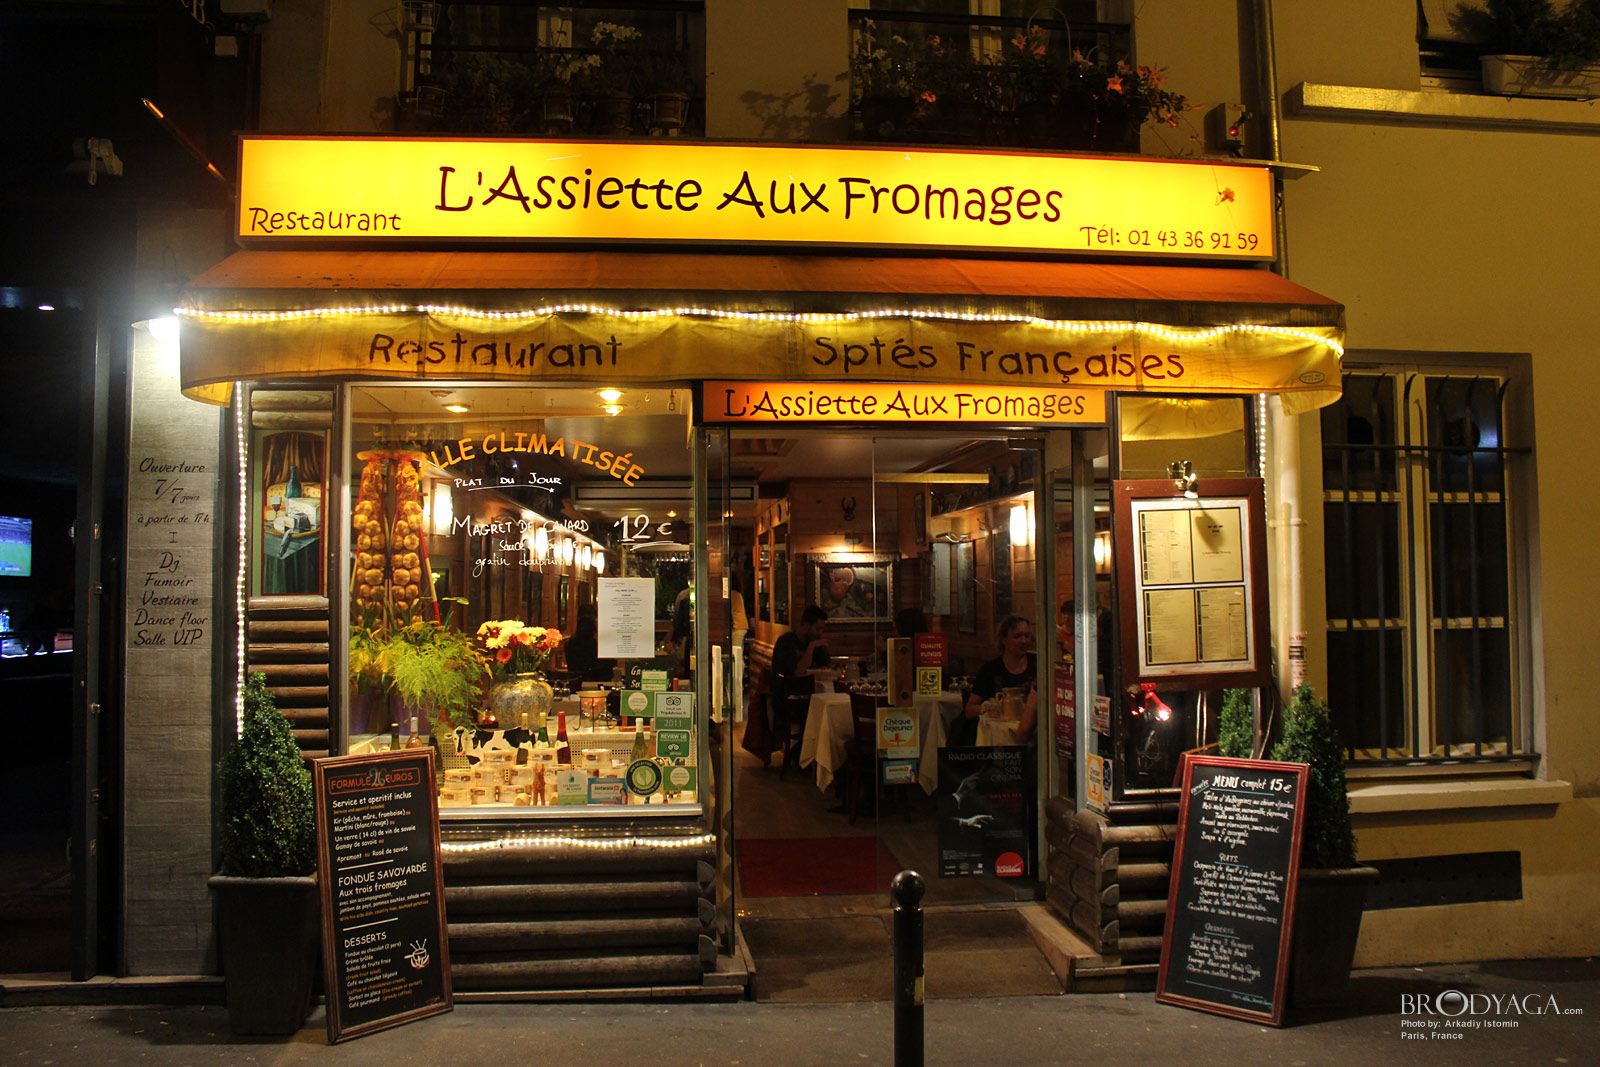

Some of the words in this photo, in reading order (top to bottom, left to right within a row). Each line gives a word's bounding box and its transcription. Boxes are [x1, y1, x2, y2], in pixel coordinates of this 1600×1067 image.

[434, 165, 702, 213] L'Assiette
[716, 171, 830, 218] Aux
[838, 177, 1063, 226] Fromages
[248, 207, 402, 234] Restaurant
[1080, 224, 1120, 247] Tél:
[1128, 230, 1151, 246] 01
[1157, 230, 1178, 248] 43
[1184, 231, 1204, 249] 36
[1211, 232, 1231, 249] 91
[1237, 232, 1258, 250] 59
[369, 332, 622, 368] Restaurant
[812, 337, 937, 373] Sptés
[956, 341, 1185, 383] Françaises
[724, 390, 877, 419] L'Assiette
[883, 390, 948, 419] Aux
[956, 393, 1086, 419] Fromages
[139, 457, 205, 473] Ouverture
[482, 432, 645, 487] CLIMATISÉE
[454, 478, 482, 488] PLAT
[145, 514, 175, 527] partir
[178, 515, 189, 523] de
[518, 520, 533, 532] DE
[542, 519, 589, 532] CANARD
[614, 514, 650, 543] 12
[159, 551, 181, 572] Dj
[473, 552, 511, 578] gratin
[144, 572, 193, 587] Fumoir
[142, 590, 198, 606] Vestiaire
[134, 608, 175, 627] Dance
[179, 611, 208, 628] floor
[133, 629, 166, 646] Salle
[173, 628, 203, 645] VIP
[885, 717, 911, 726] Chèque
[976, 751, 1022, 760] CLASSIQUE
[331, 776, 371, 790] FORMULE
[369, 767, 387, 787] 26
[385, 772, 413, 783] EUROS
[1212, 775, 1240, 789] MENU
[1240, 778, 1267, 791] complet
[332, 799, 358, 808] Service
[359, 797, 366, 805] et
[394, 791, 412, 800] inclus
[338, 871, 375, 887] FONDUE
[377, 862, 427, 880] SAVOYARDE
[339, 889, 354, 898] Aux
[355, 884, 373, 894] trois
[374, 879, 407, 890] fromages
[344, 931, 387, 949] DESSERTS
